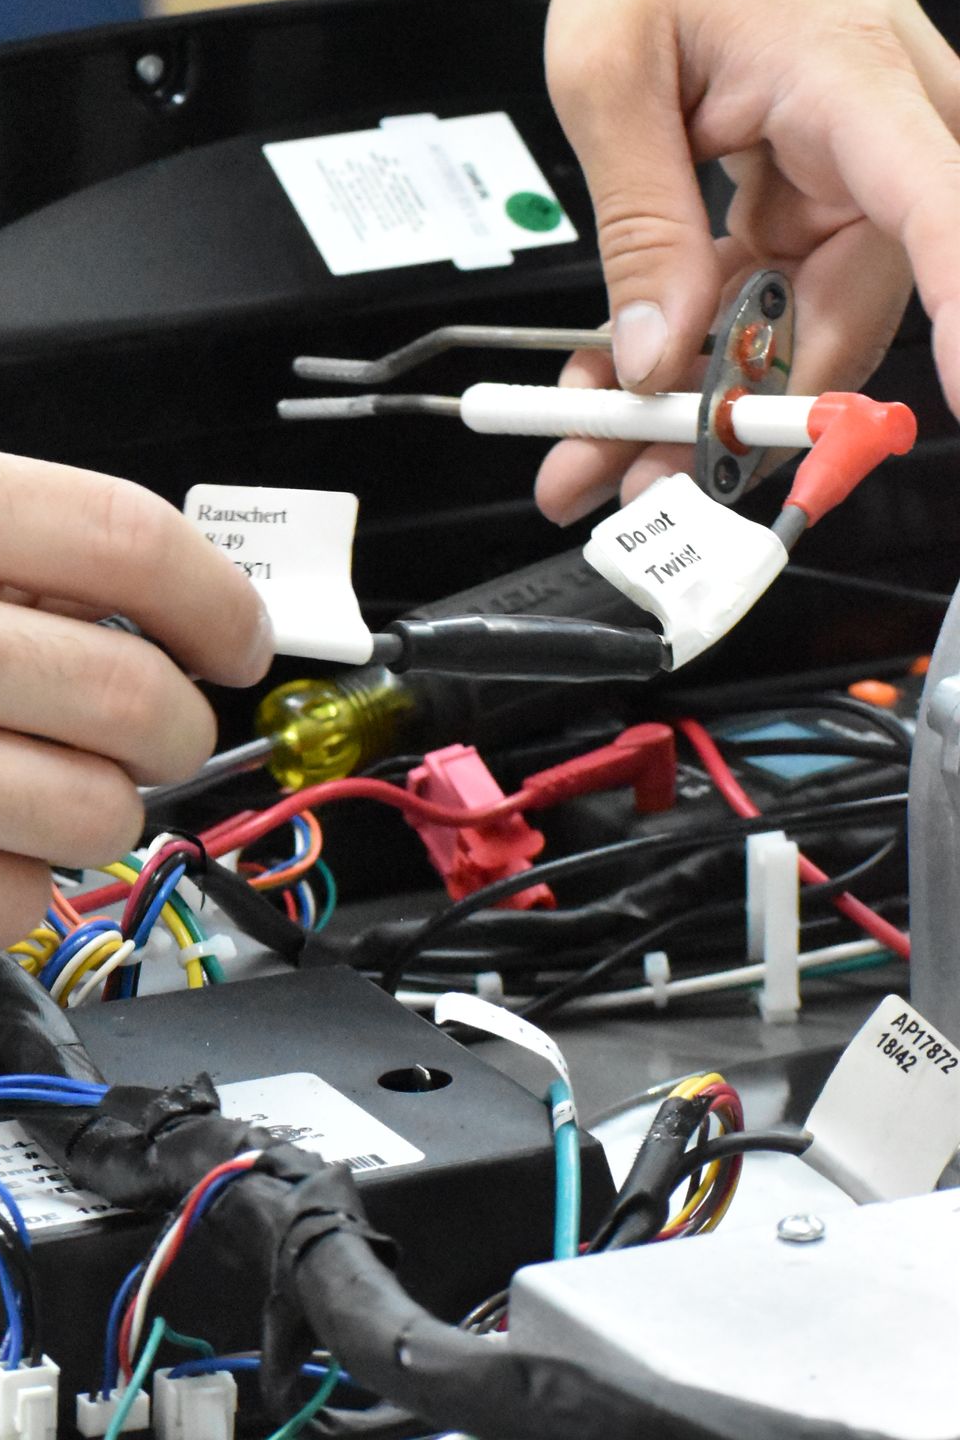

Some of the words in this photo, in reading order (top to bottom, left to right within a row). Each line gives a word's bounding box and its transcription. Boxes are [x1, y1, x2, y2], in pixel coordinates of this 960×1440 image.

[197, 504, 288, 524] Rauschert
[615, 530, 647, 553] Do
[645, 510, 676, 536] not
[205, 532, 245, 551] 8/49
[233, 561, 273, 580] 871
[644, 543, 702, 585] Twist!
[876, 1031, 919, 1074] 18/42
[890, 1012, 959, 1075] AP17872
